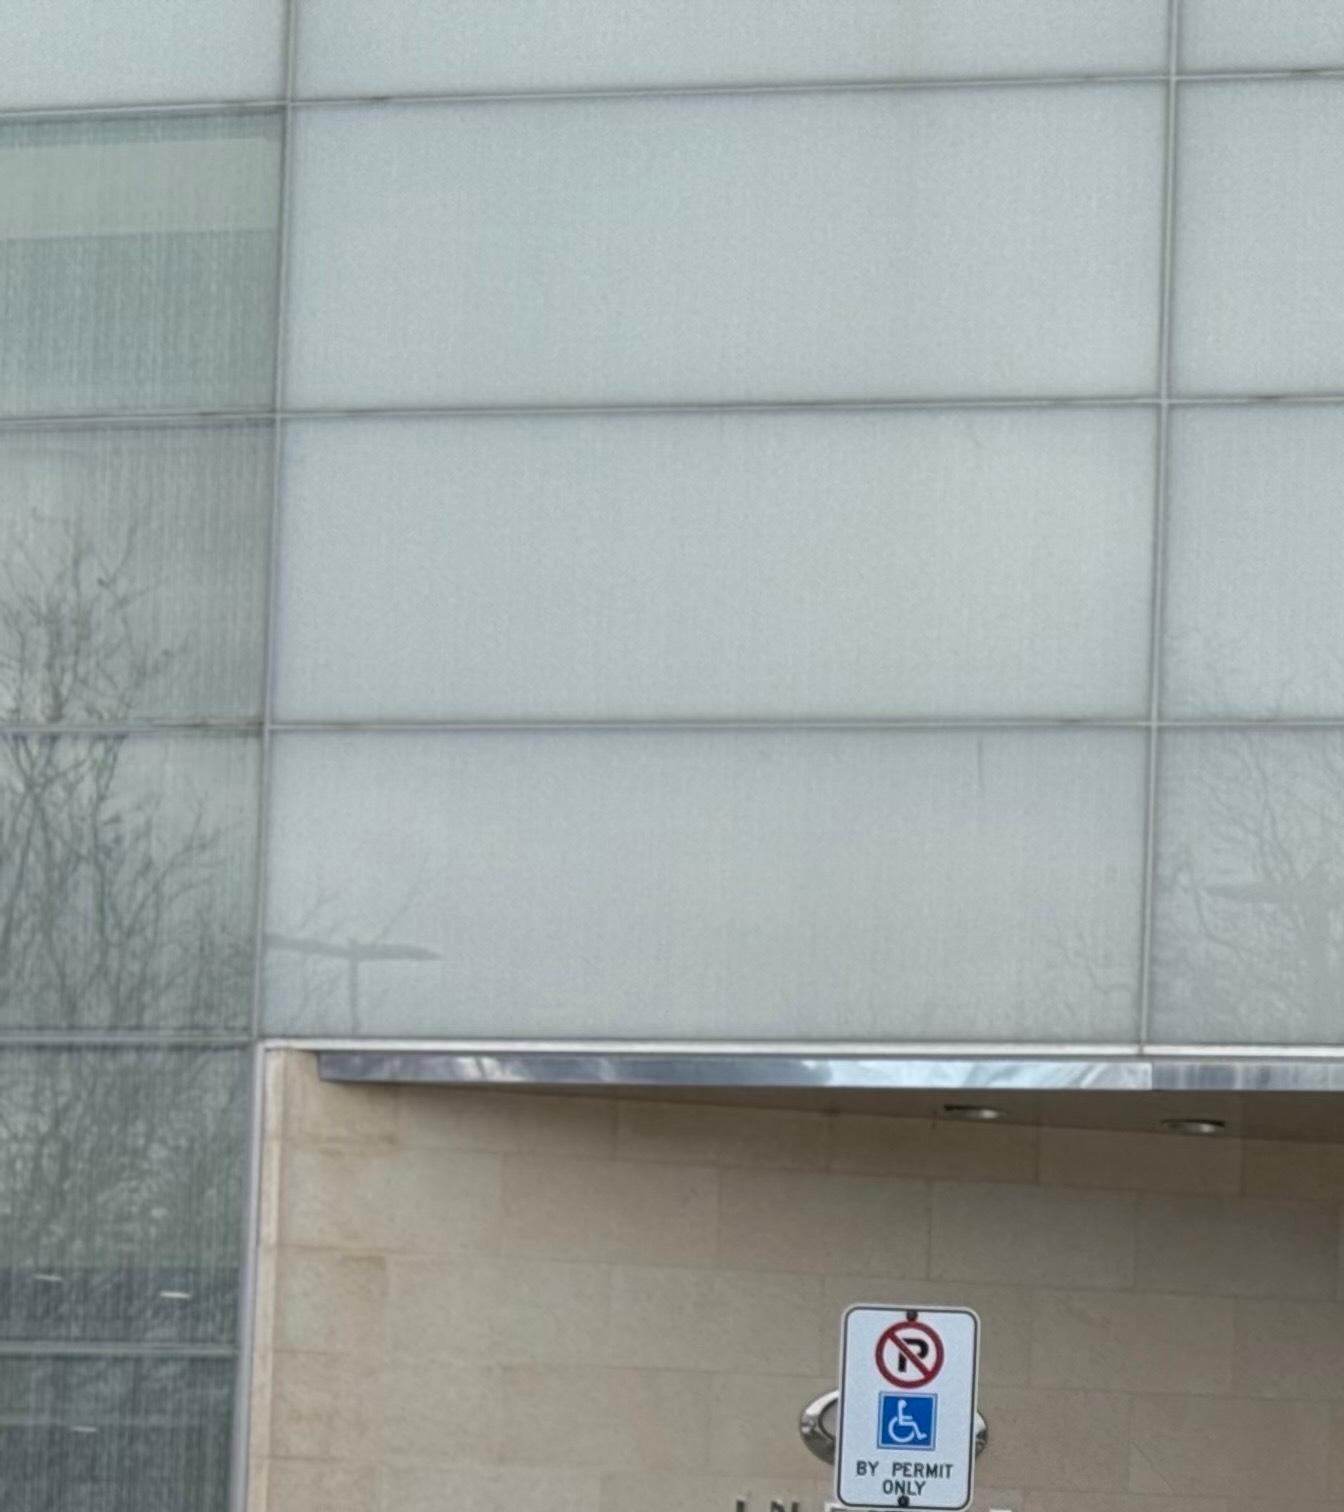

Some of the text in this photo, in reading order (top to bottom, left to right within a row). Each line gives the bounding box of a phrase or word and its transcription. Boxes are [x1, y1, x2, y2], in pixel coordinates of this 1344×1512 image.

[856, 1461, 953, 1479] BY PERMIT
[882, 1480, 926, 1497] ONLY
